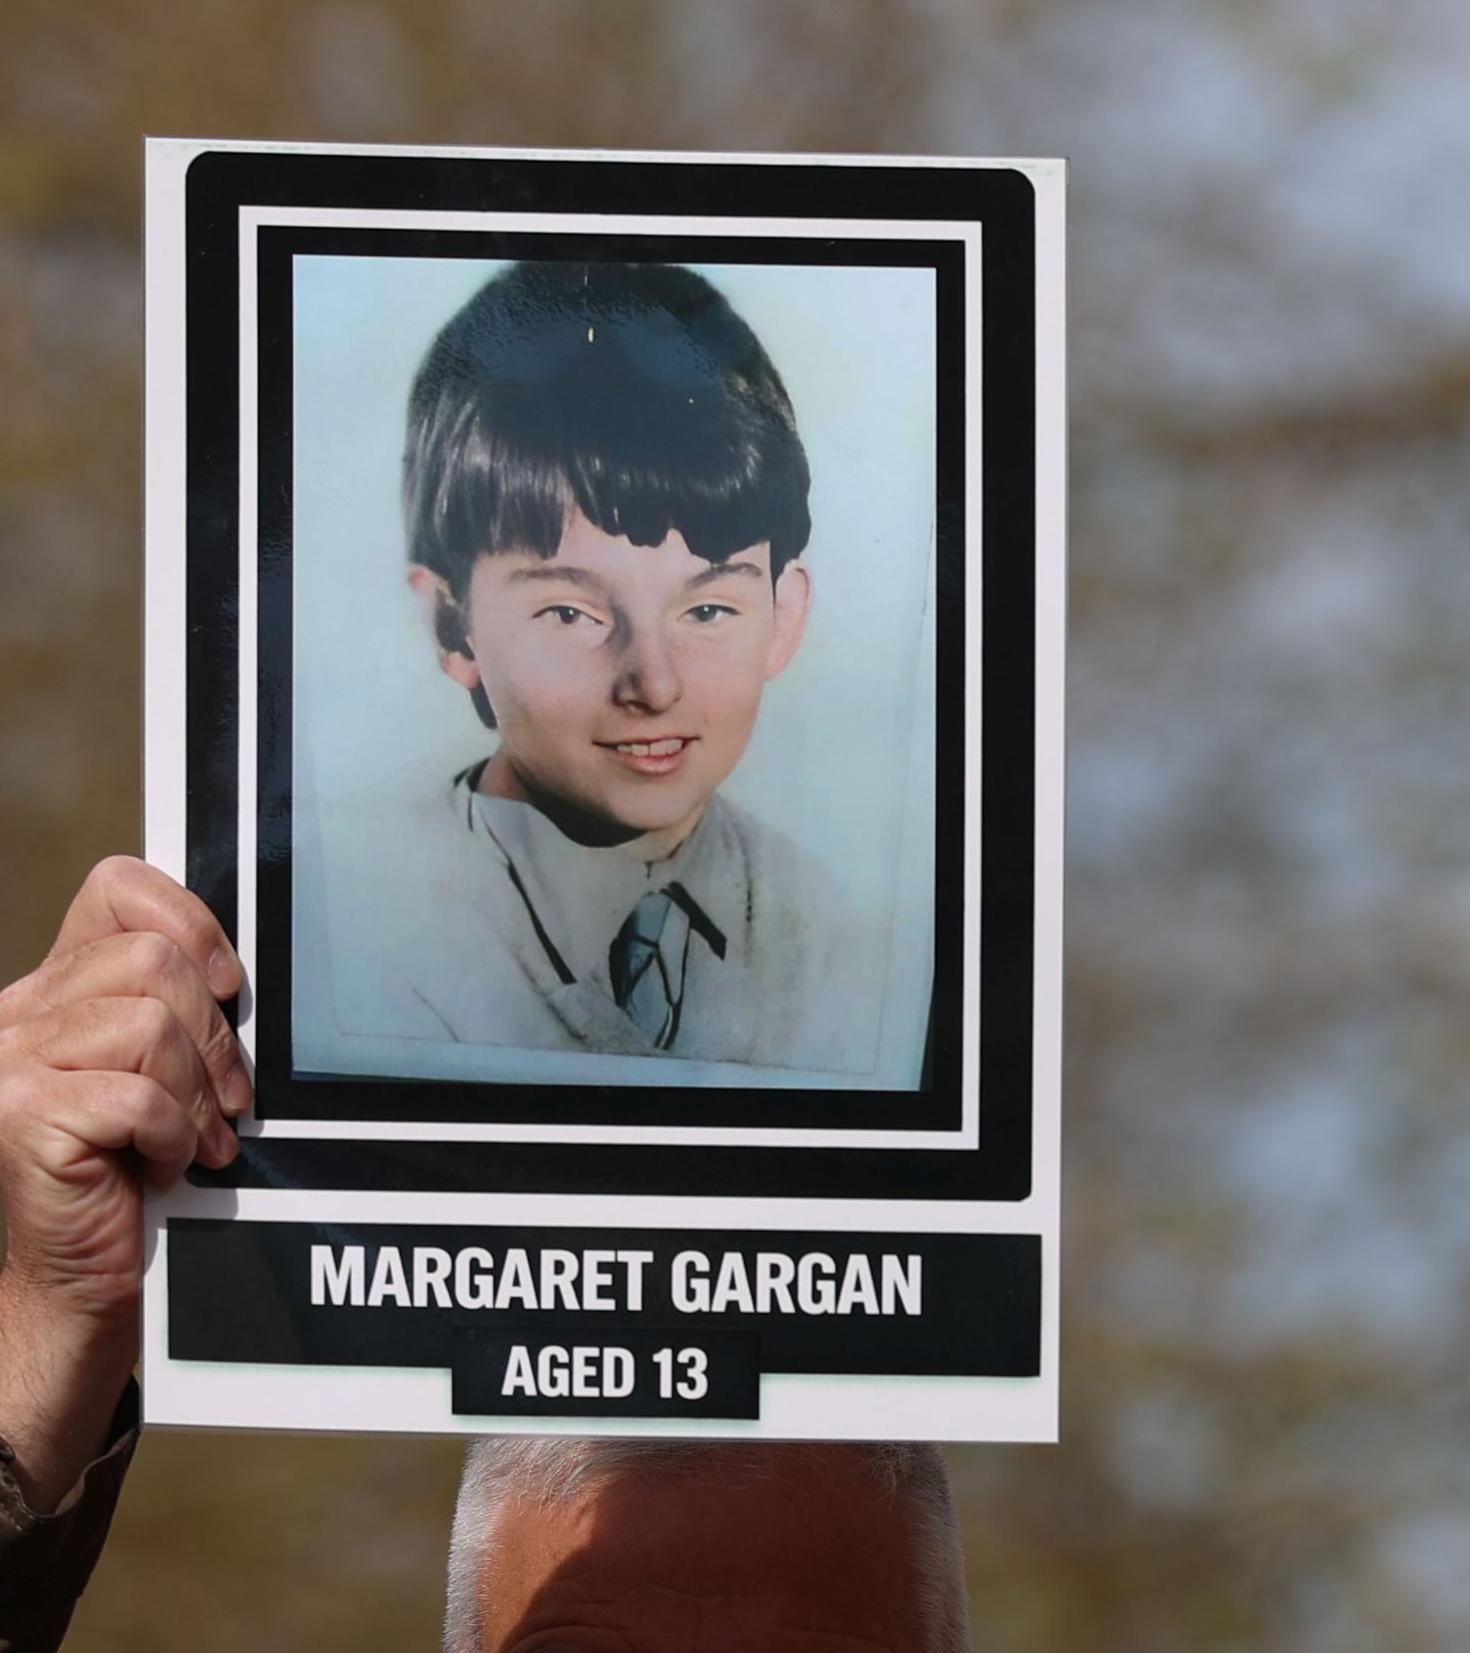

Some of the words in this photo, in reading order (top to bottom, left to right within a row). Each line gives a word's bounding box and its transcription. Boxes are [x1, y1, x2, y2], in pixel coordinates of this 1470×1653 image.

[309, 1244, 653, 1312] MARGARET
[671, 1250, 923, 1317] GARGAN
[500, 1344, 635, 1399] AGED
[651, 1347, 709, 1401] 13
